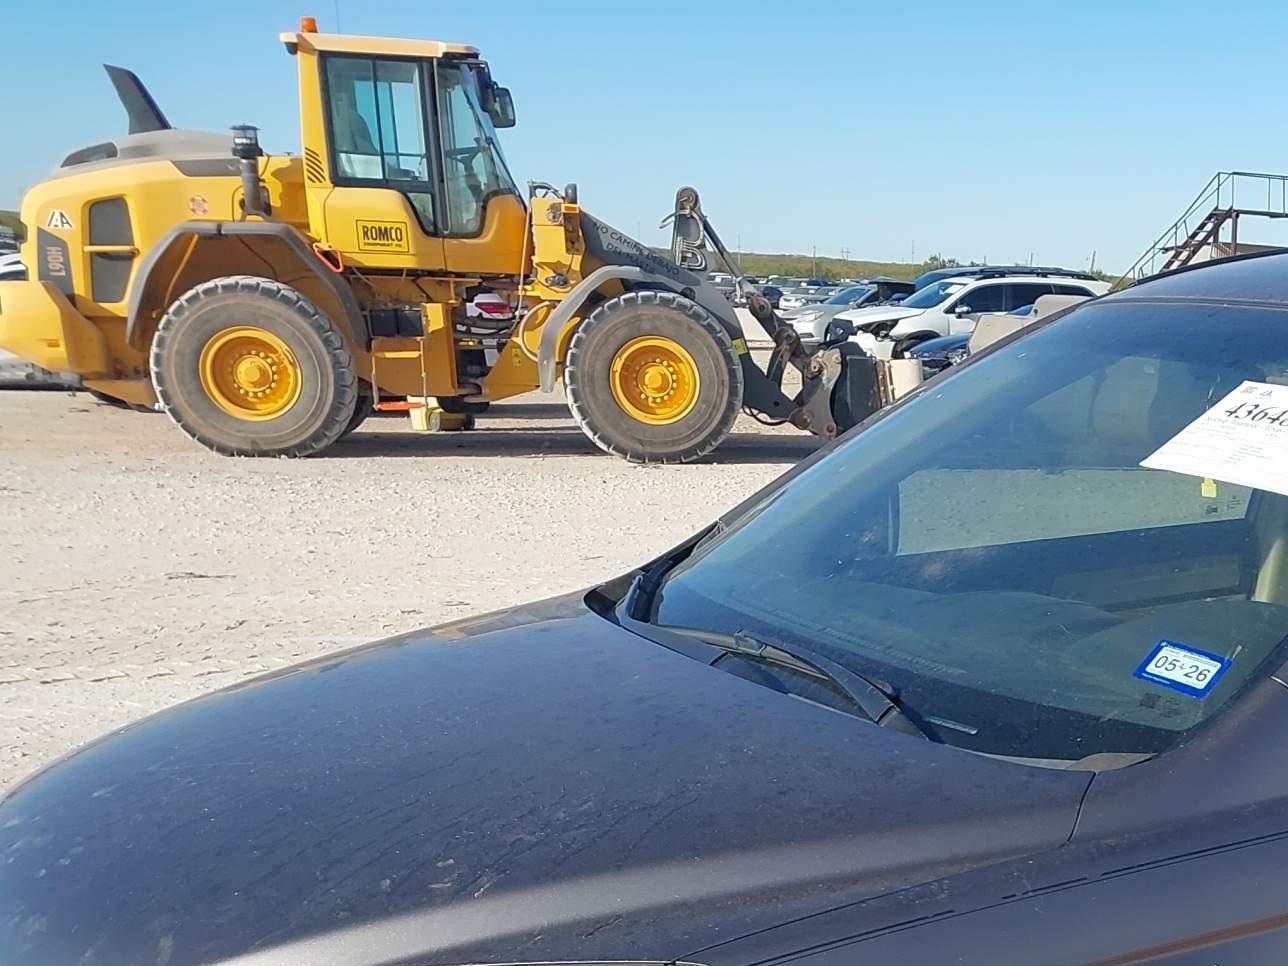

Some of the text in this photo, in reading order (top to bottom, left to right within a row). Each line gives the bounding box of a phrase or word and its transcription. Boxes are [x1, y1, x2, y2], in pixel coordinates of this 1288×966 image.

[362, 225, 403, 241] ROMCO
[593, 222, 609, 235] NO
[46, 246, 66, 276] L90H
[1154, 656, 1181, 672] 05
[1183, 665, 1211, 682] 26
